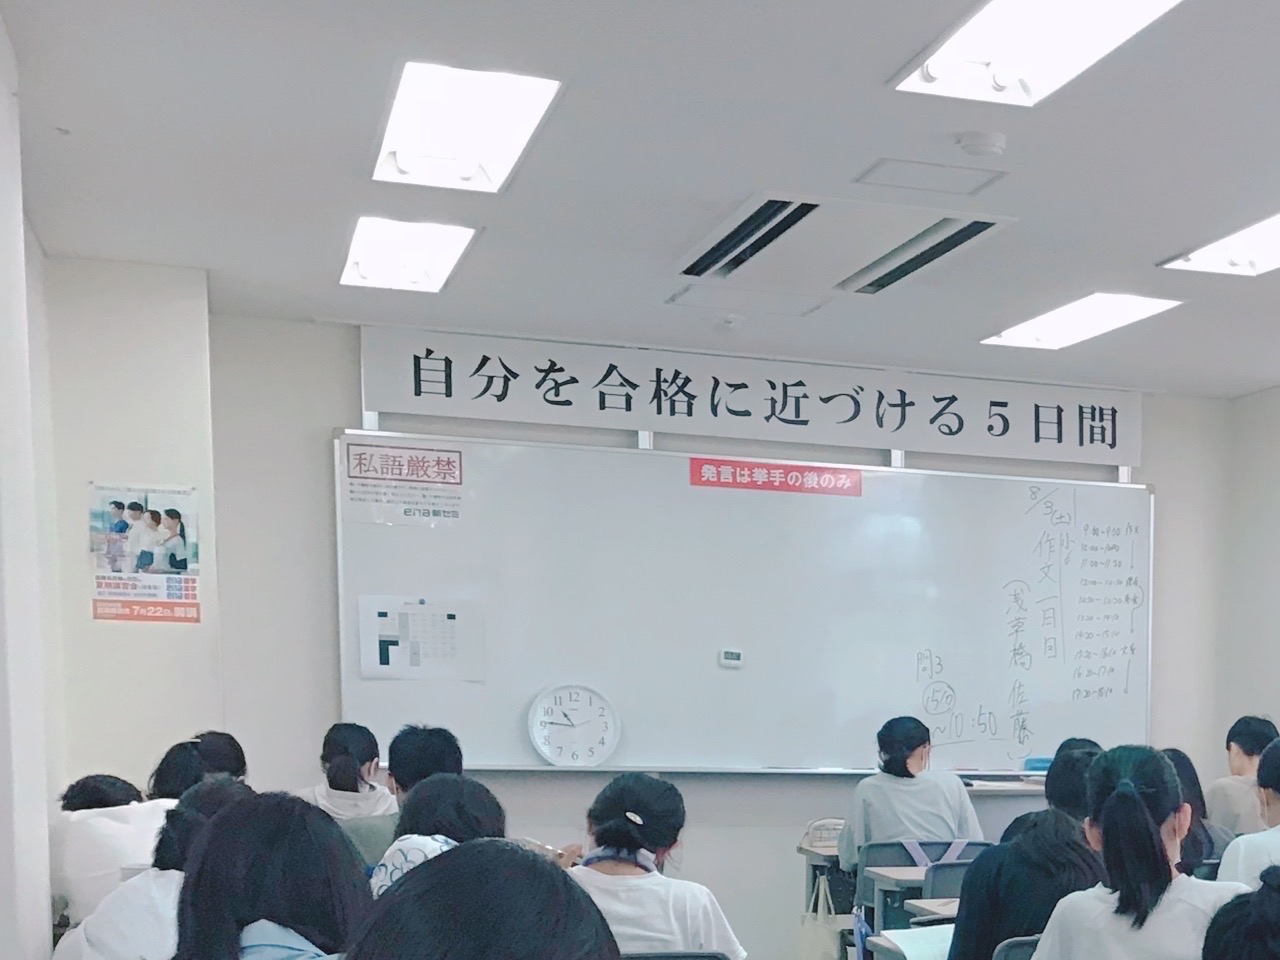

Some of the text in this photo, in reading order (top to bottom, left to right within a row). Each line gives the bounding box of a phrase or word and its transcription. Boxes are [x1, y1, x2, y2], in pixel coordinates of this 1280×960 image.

[412, 347, 1119, 450] 自分を合格に近づける5日間
[352, 452, 457, 480] 私語厳禁
[701, 464, 852, 489] 発言は挙手の後のみ
[554, 696, 562, 706] 11
[569, 691, 580, 702] 12
[588, 696, 593, 706] 1
[543, 706, 554, 717] 10
[598, 706, 605, 717] 2
[540, 720, 547, 730] 9
[602, 721, 608, 732] 3
[543, 735, 551, 746] 8
[598, 736, 605, 746] 4
[556, 746, 563, 756] 7
[571, 750, 579, 760] 6
[588, 747, 595, 757] 5
